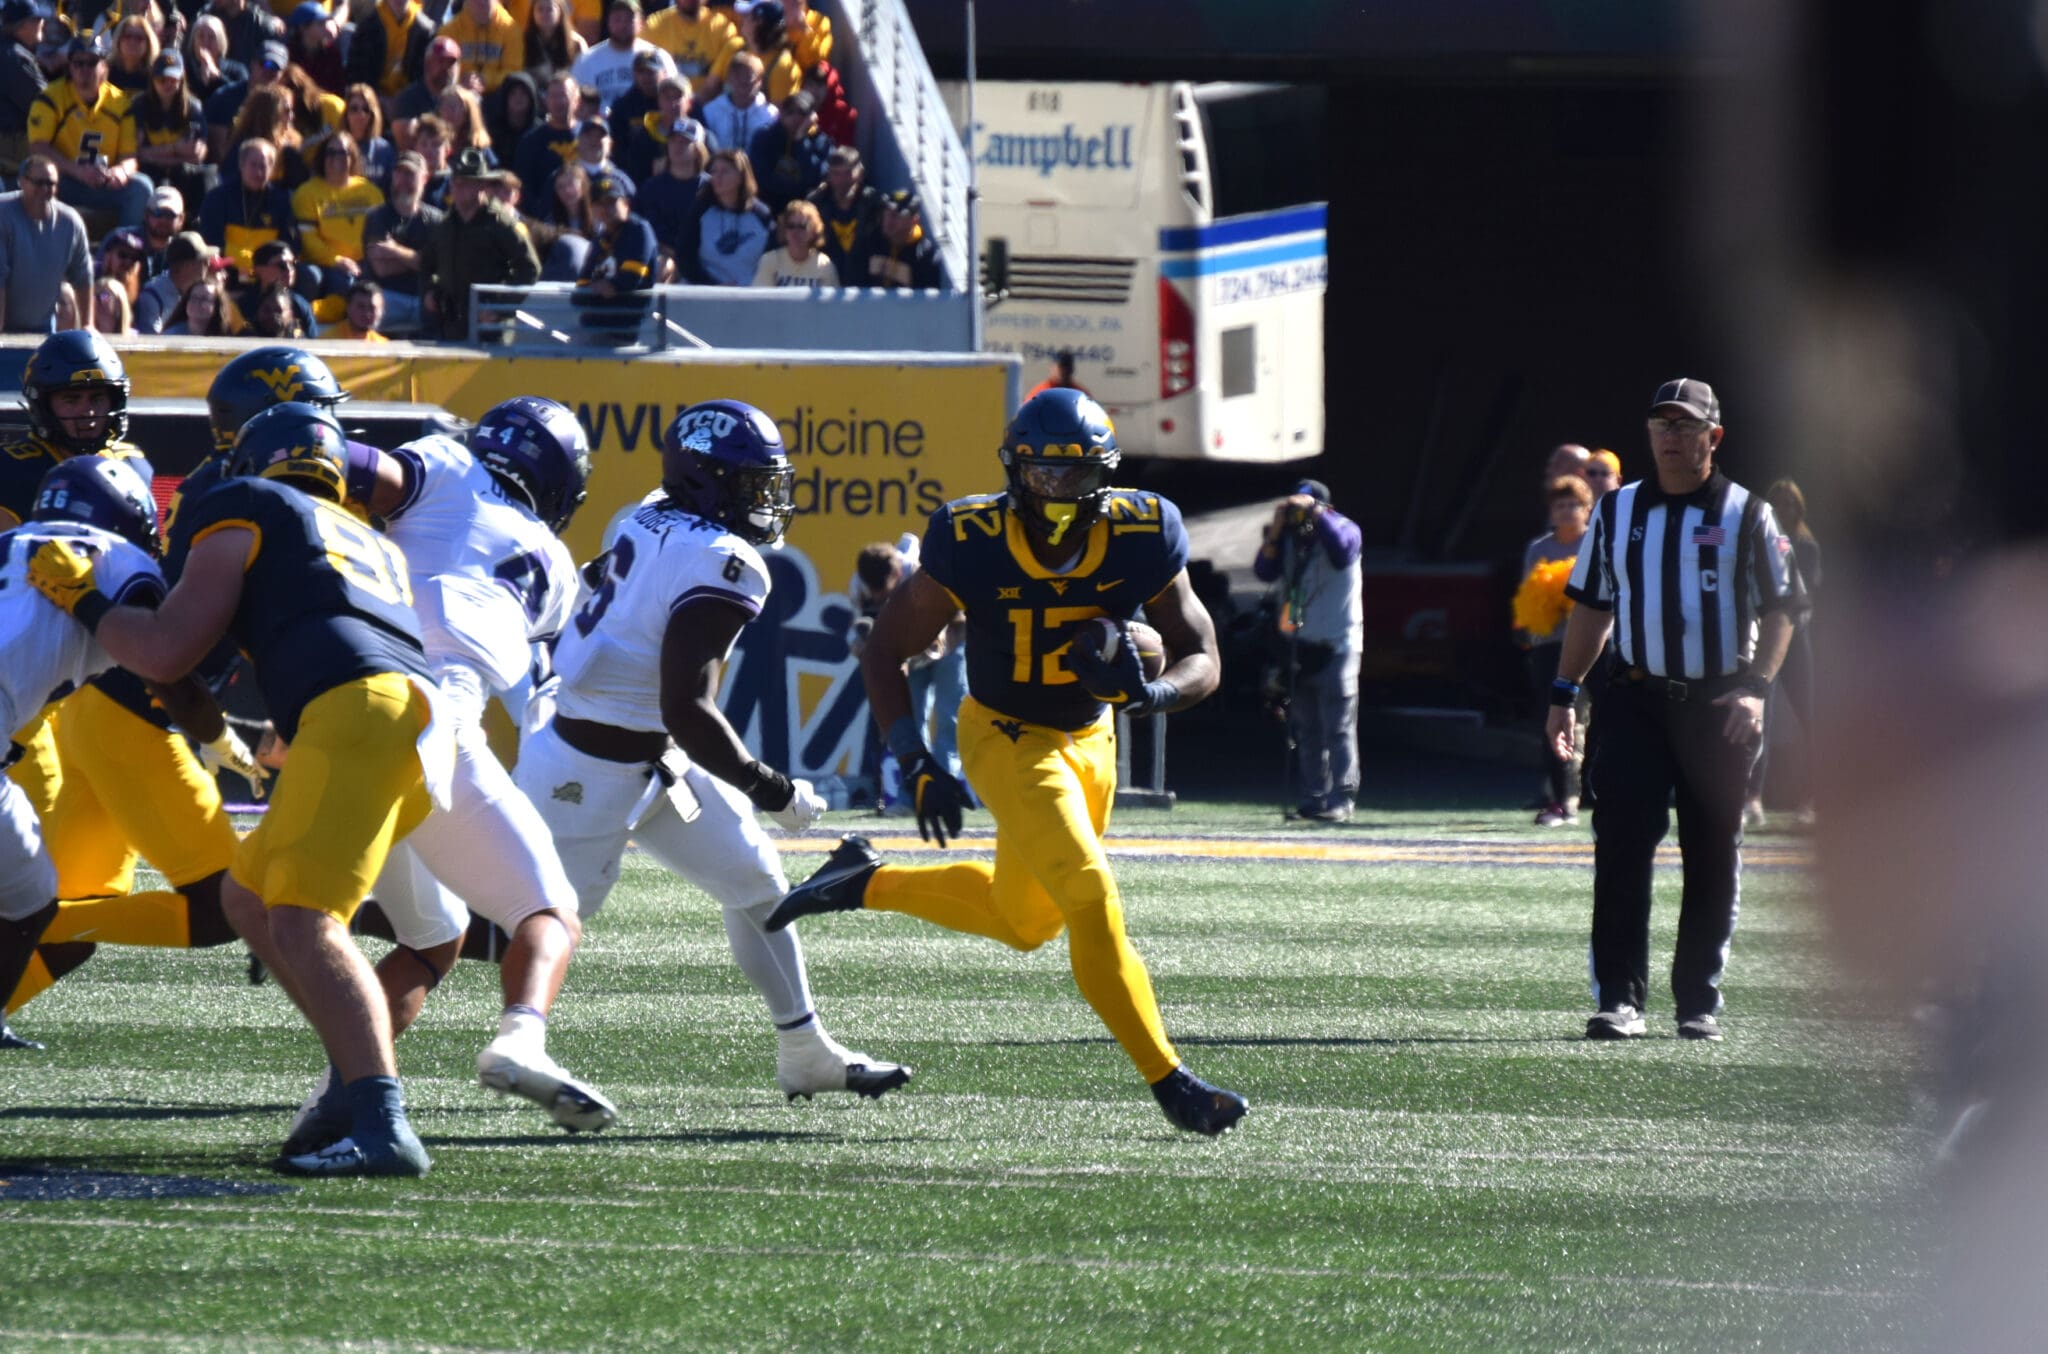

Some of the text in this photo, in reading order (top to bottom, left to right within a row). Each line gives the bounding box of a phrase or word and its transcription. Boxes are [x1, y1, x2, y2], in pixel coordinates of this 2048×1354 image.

[964, 121, 1134, 177] Campbell
[499, 426, 515, 445] 4
[678, 410, 738, 439] TCU
[780, 408, 926, 458] dicine
[39, 490, 69, 509] 26
[794, 467, 945, 518] dren's
[1111, 497, 1161, 536] 12
[1631, 526, 1644, 541] S
[722, 552, 746, 584] 6
[1701, 569, 1718, 592] C
[574, 533, 637, 640] 6
[1008, 606, 1110, 686] 12
